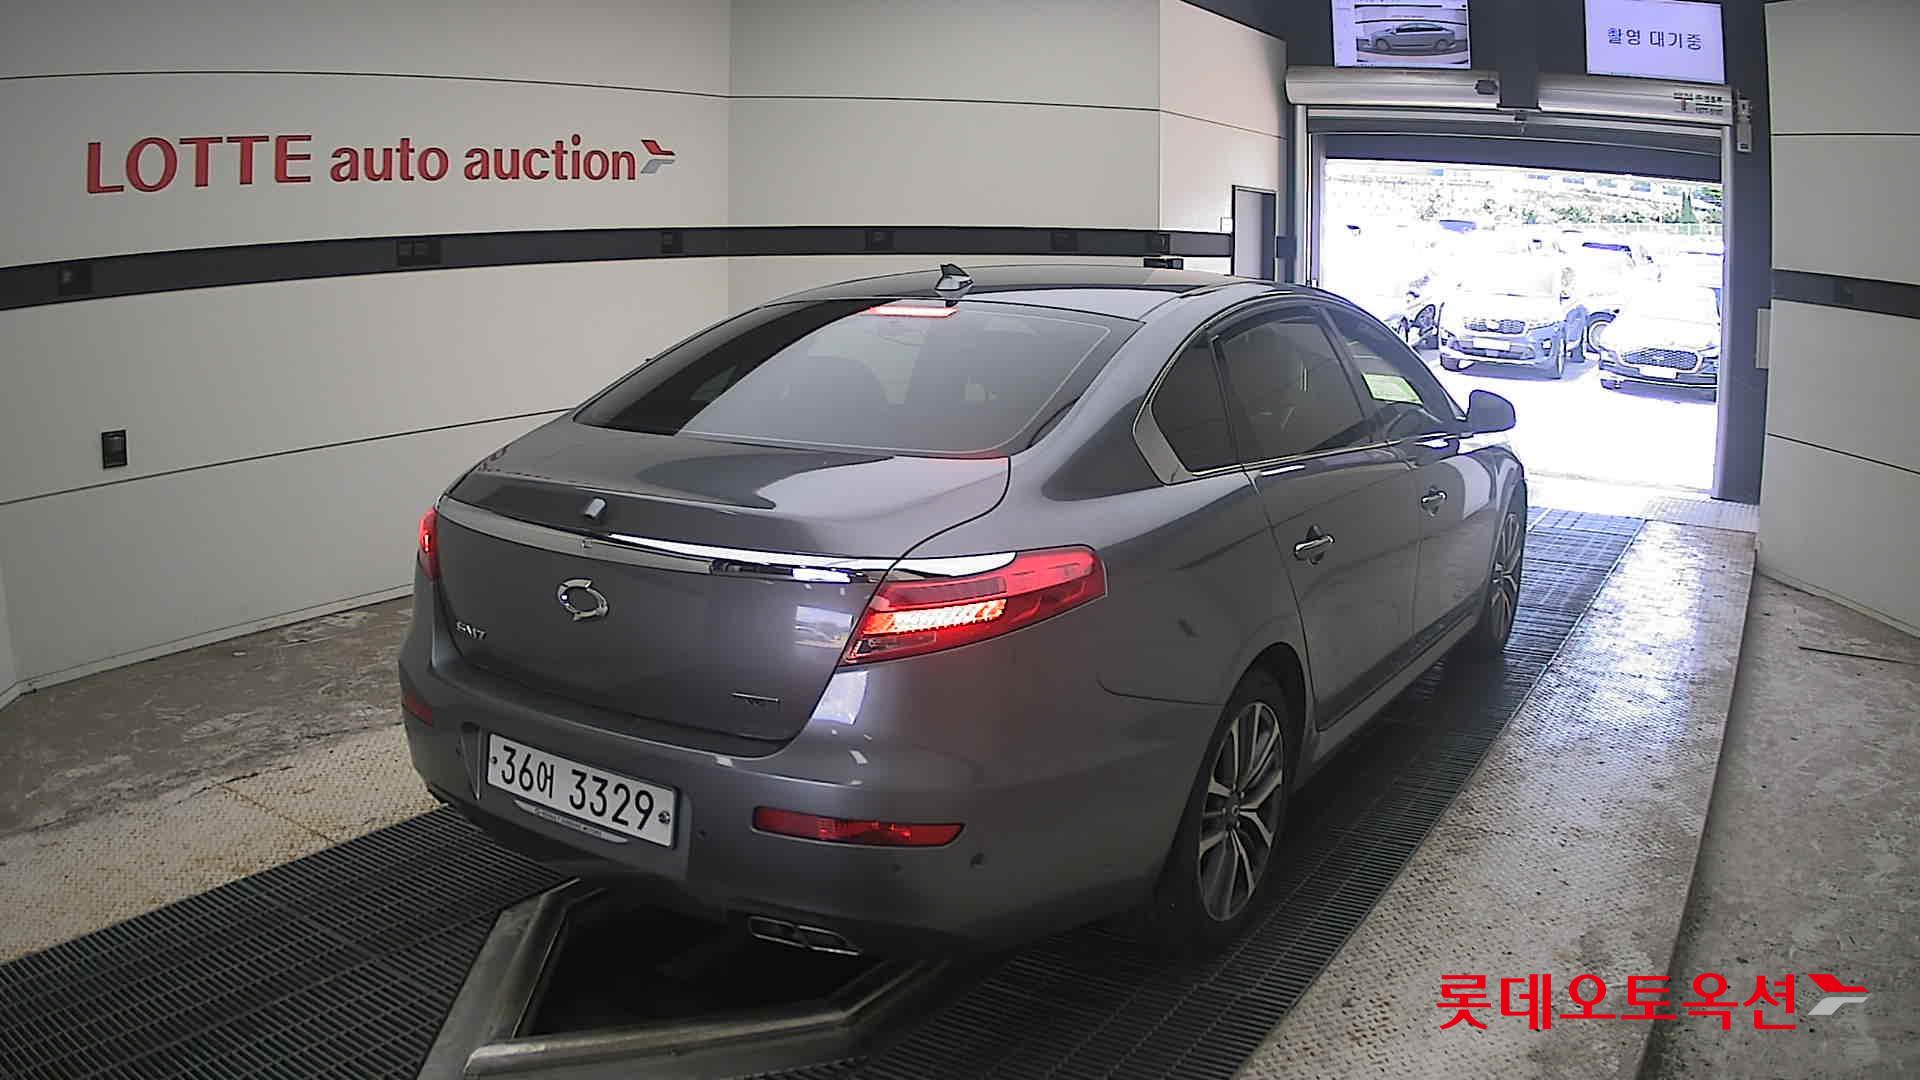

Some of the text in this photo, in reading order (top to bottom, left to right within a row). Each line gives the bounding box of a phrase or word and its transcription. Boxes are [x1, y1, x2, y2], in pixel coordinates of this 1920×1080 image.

[1649, 31, 1702, 51] 대기중
[87, 134, 638, 194] LOTTE auto auction
[501, 745, 555, 799] 36어
[569, 768, 655, 831] 3329
